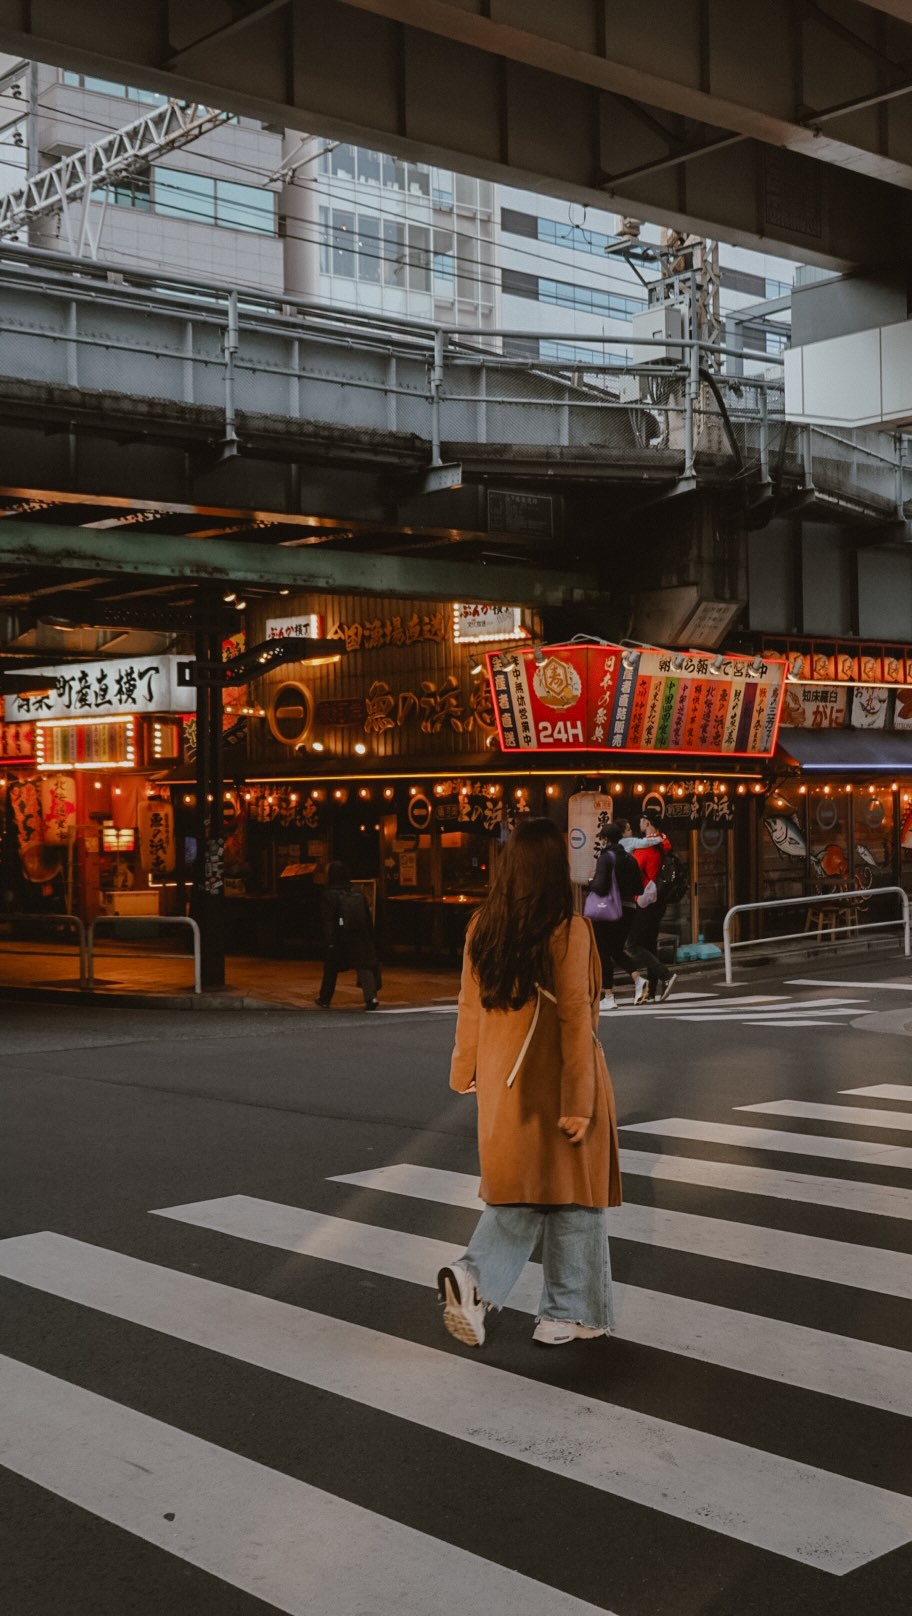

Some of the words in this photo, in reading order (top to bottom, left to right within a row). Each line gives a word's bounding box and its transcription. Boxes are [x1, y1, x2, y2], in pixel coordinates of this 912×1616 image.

[490, 655, 516, 747] 生産者直送
[510, 654, 532, 746] 年中無休営業中
[538, 719, 584, 743] 24H
